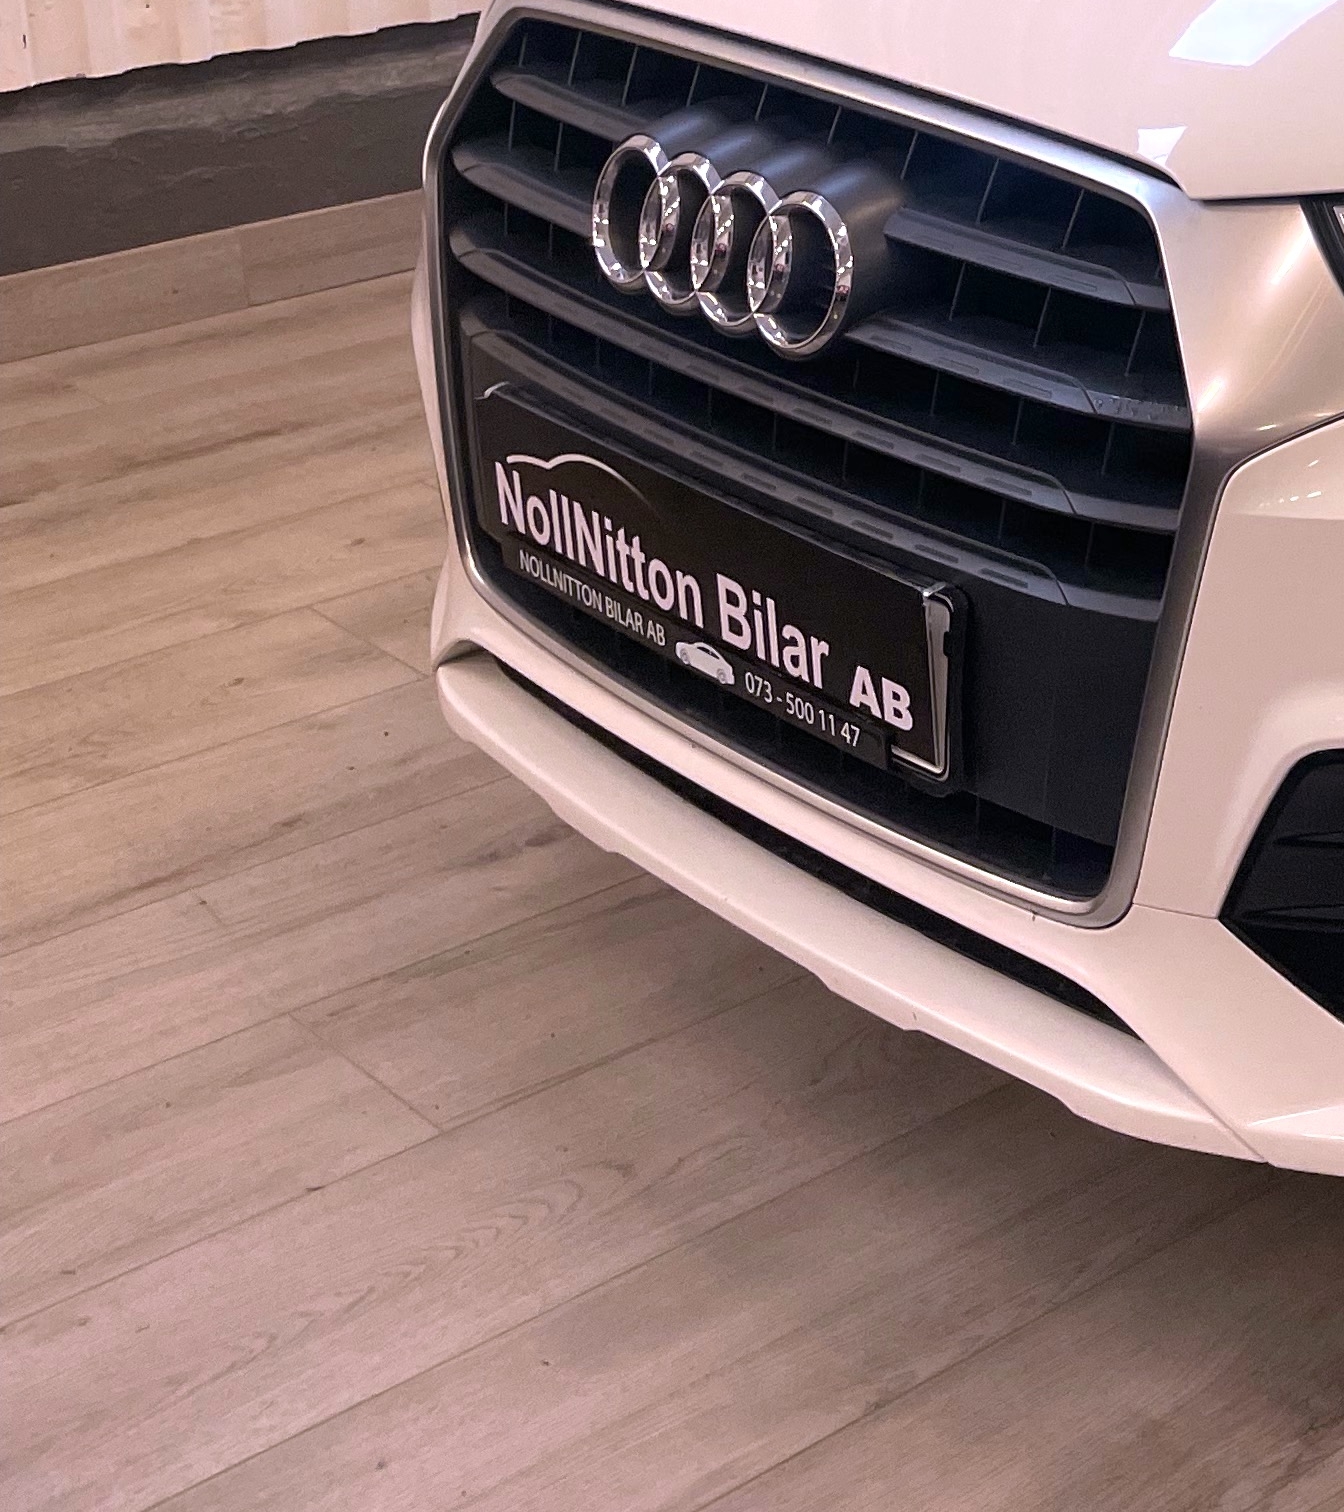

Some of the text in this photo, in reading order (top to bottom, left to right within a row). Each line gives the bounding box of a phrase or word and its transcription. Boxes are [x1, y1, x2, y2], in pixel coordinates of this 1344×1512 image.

[495, 461, 913, 731] NollNitton Bilar AB
[519, 549, 666, 647] NOLLNITTON BILAR AB
[786, 691, 815, 725] 500
[820, 708, 836, 737] 11
[840, 721, 861, 747] 47
